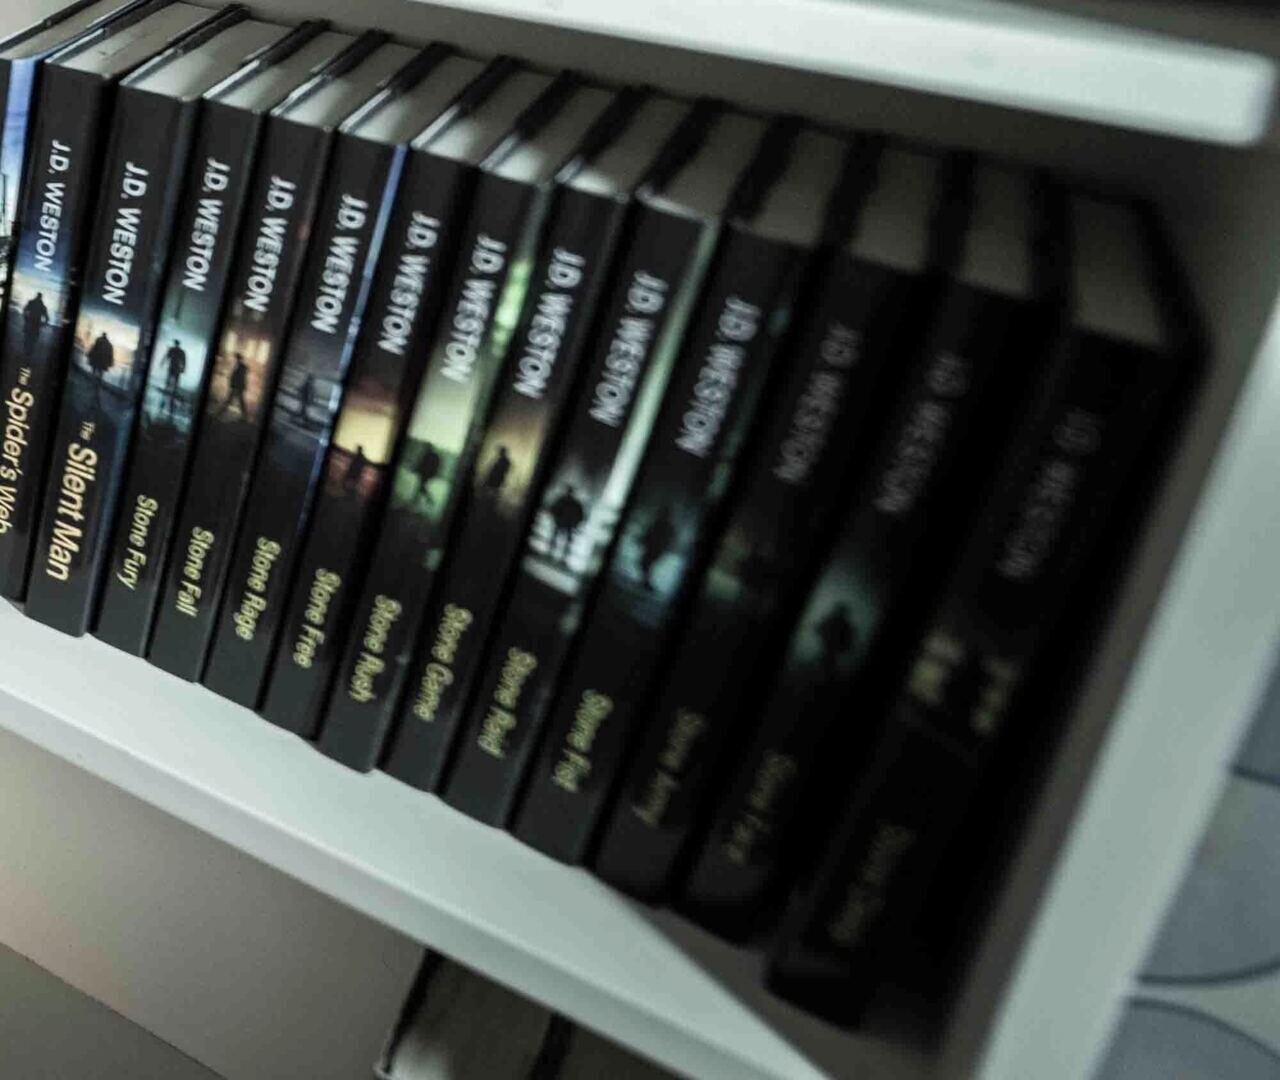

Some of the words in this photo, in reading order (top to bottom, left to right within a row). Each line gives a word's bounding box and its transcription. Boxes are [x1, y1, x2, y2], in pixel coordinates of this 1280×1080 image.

[48, 138, 72, 174] J.D.
[120, 161, 150, 200] J.D.
[33, 181, 67, 272] WESTON
[101, 206, 143, 306] WESTON
[182, 197, 224, 292] WESTON
[243, 216, 289, 313] WESTON
[310, 235, 360, 334] WESTON
[377, 253, 431, 356] WESTON
[440, 278, 497, 384] WESTON
[56, 441, 98, 522] Silent
[45, 519, 83, 582] Man
[128, 494, 159, 548] Stone
[116, 547, 147, 591] Fury
[183, 525, 215, 581] Stone
[247, 536, 282, 593] Stone
[175, 579, 203, 618] Fall
[304, 567, 342, 626] Stone
